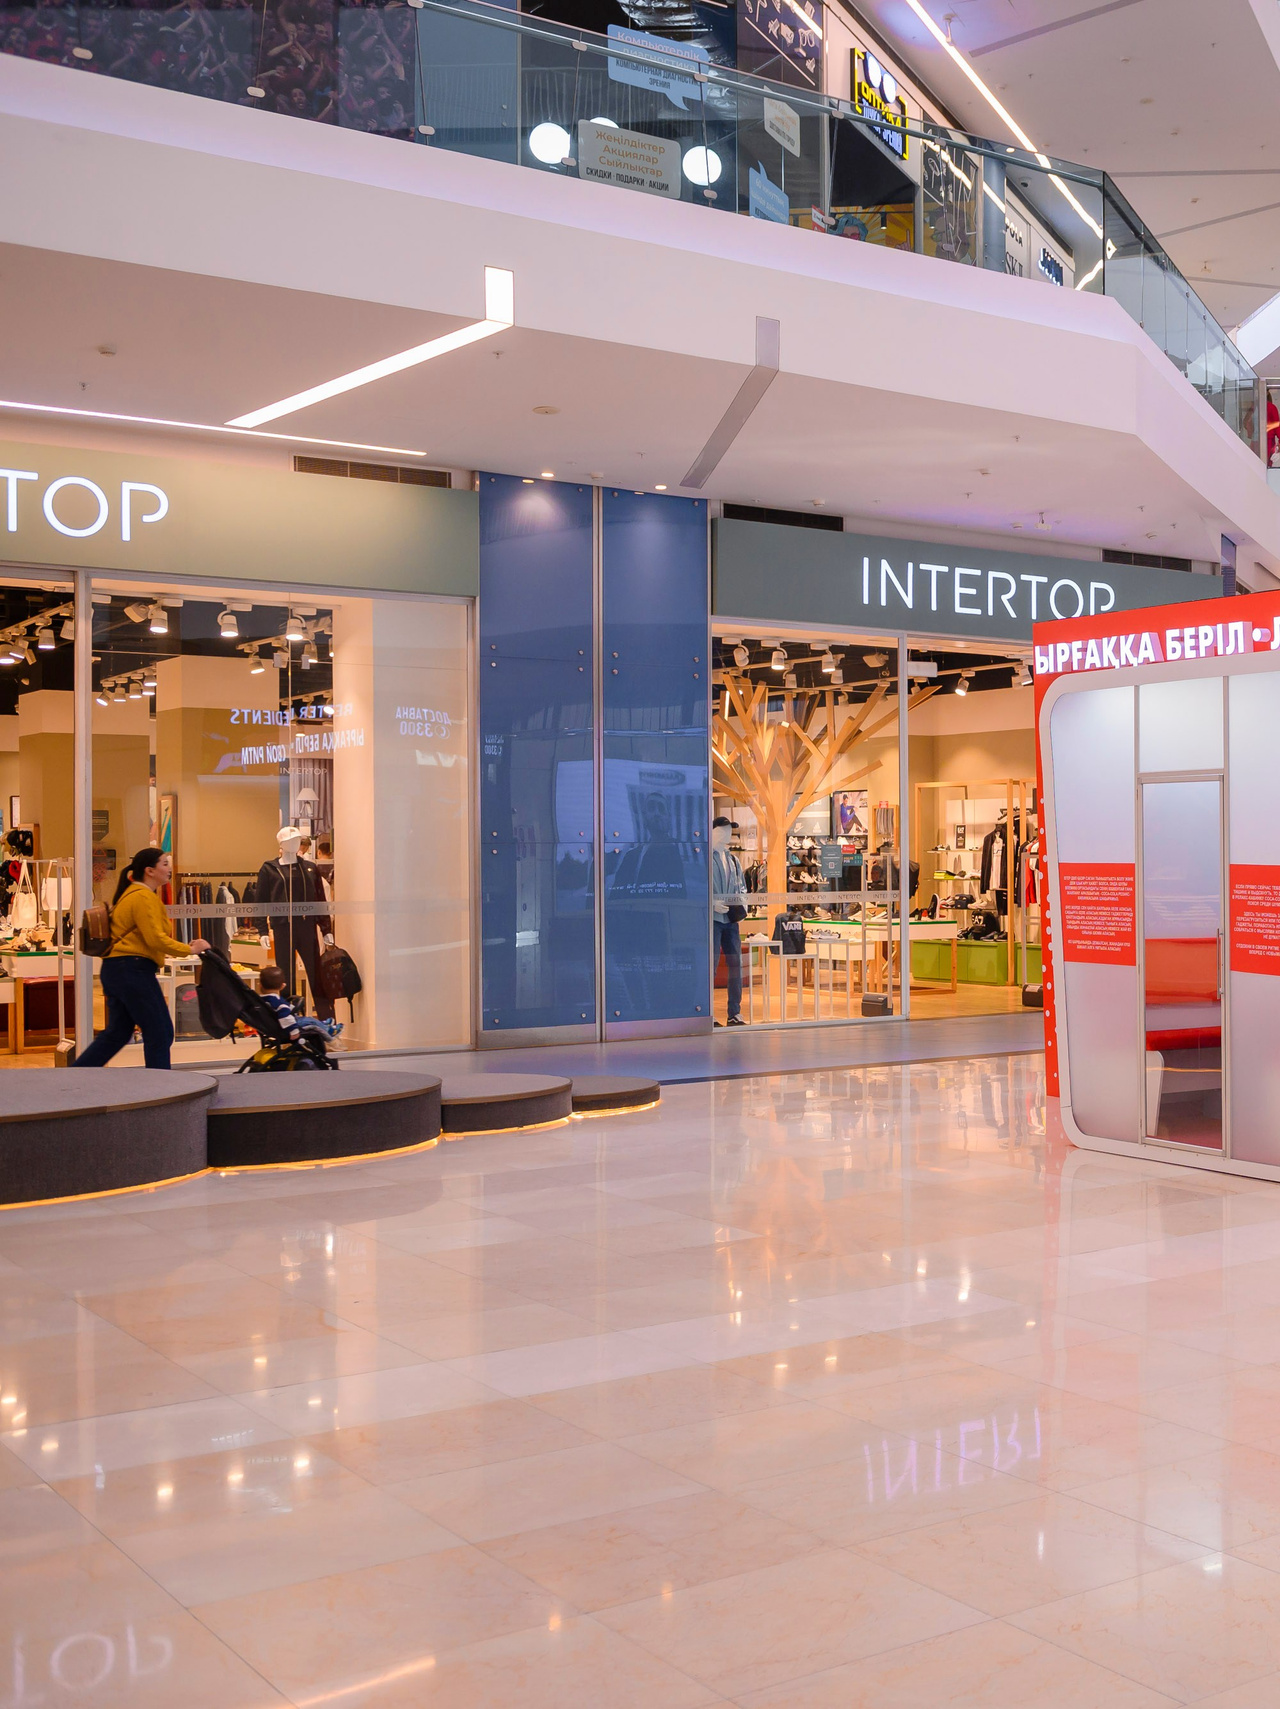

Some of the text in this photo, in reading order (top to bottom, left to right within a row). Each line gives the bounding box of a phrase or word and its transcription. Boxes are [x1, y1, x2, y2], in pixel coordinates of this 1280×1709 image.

[649, 77, 671, 90] ЗРЕНИЯ
[595, 130, 666, 155] Жеңілдіктер
[598, 155, 663, 178] Сыйлықтар
[603, 145, 659, 166] Акциялар
[586, 167, 669, 192] СКИДКИ ПОДАРКИ АКЦИИ
[862, 556, 1116, 620] INTERTOP
[1035, 632, 1161, 675] ЫРҒАҚҚА
[1165, 621, 1248, 661] БЕРІЛ
